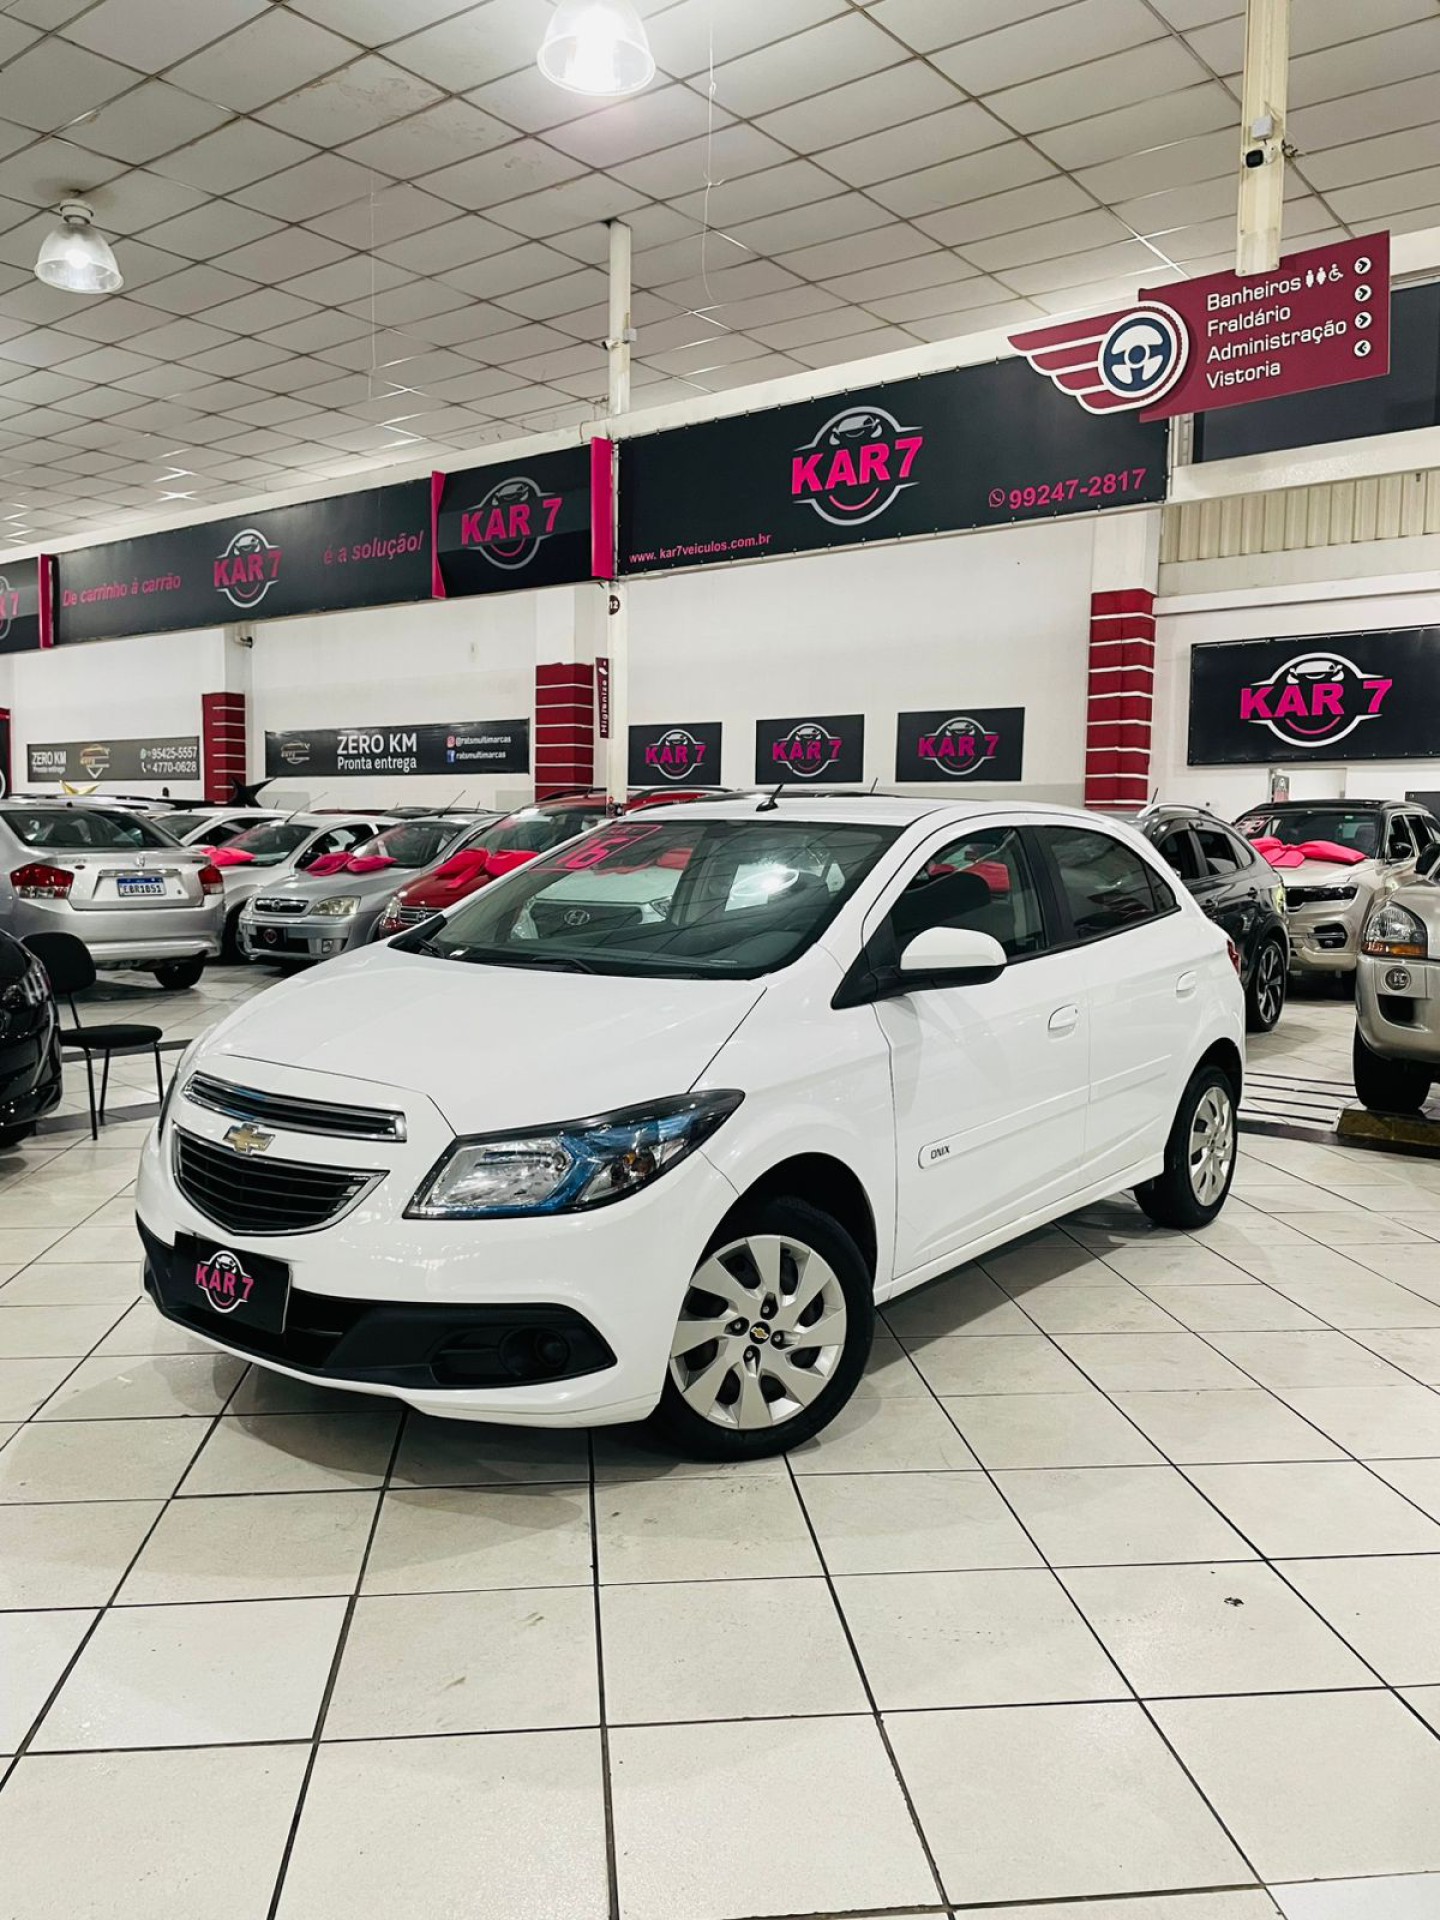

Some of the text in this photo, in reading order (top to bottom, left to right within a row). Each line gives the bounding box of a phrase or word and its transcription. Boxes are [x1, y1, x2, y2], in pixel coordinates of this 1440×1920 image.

[1207, 276, 1301, 312] Banheiros
[1207, 305, 1291, 337] Fraldário
[1206, 320, 1347, 364] Administração
[1206, 360, 1281, 389] Vistoria
[1008, 468, 1147, 510] 99247-2817
[461, 497, 563, 545] KAR 7
[323, 530, 425, 563] é a solução!
[660, 533, 772, 559] kar7veiculos.com.br
[213, 550, 283, 587] KAR 7
[62, 589, 77, 607] De
[81, 581, 127, 603] carrinho
[142, 572, 182, 594] carrão
[1240, 678, 1393, 719] KAR 7
[31, 751, 53, 765] ZERO
[54, 750, 67, 765] KM
[337, 733, 417, 754] ZERO KM
[645, 744, 707, 764] KAR 7
[772, 738, 843, 762] KAR 7
[918, 735, 999, 758] KAR 7
[337, 755, 417, 773] Pronta entrega
[930, 1145, 950, 1159] ONIX
[196, 1265, 253, 1300] KAR 7
